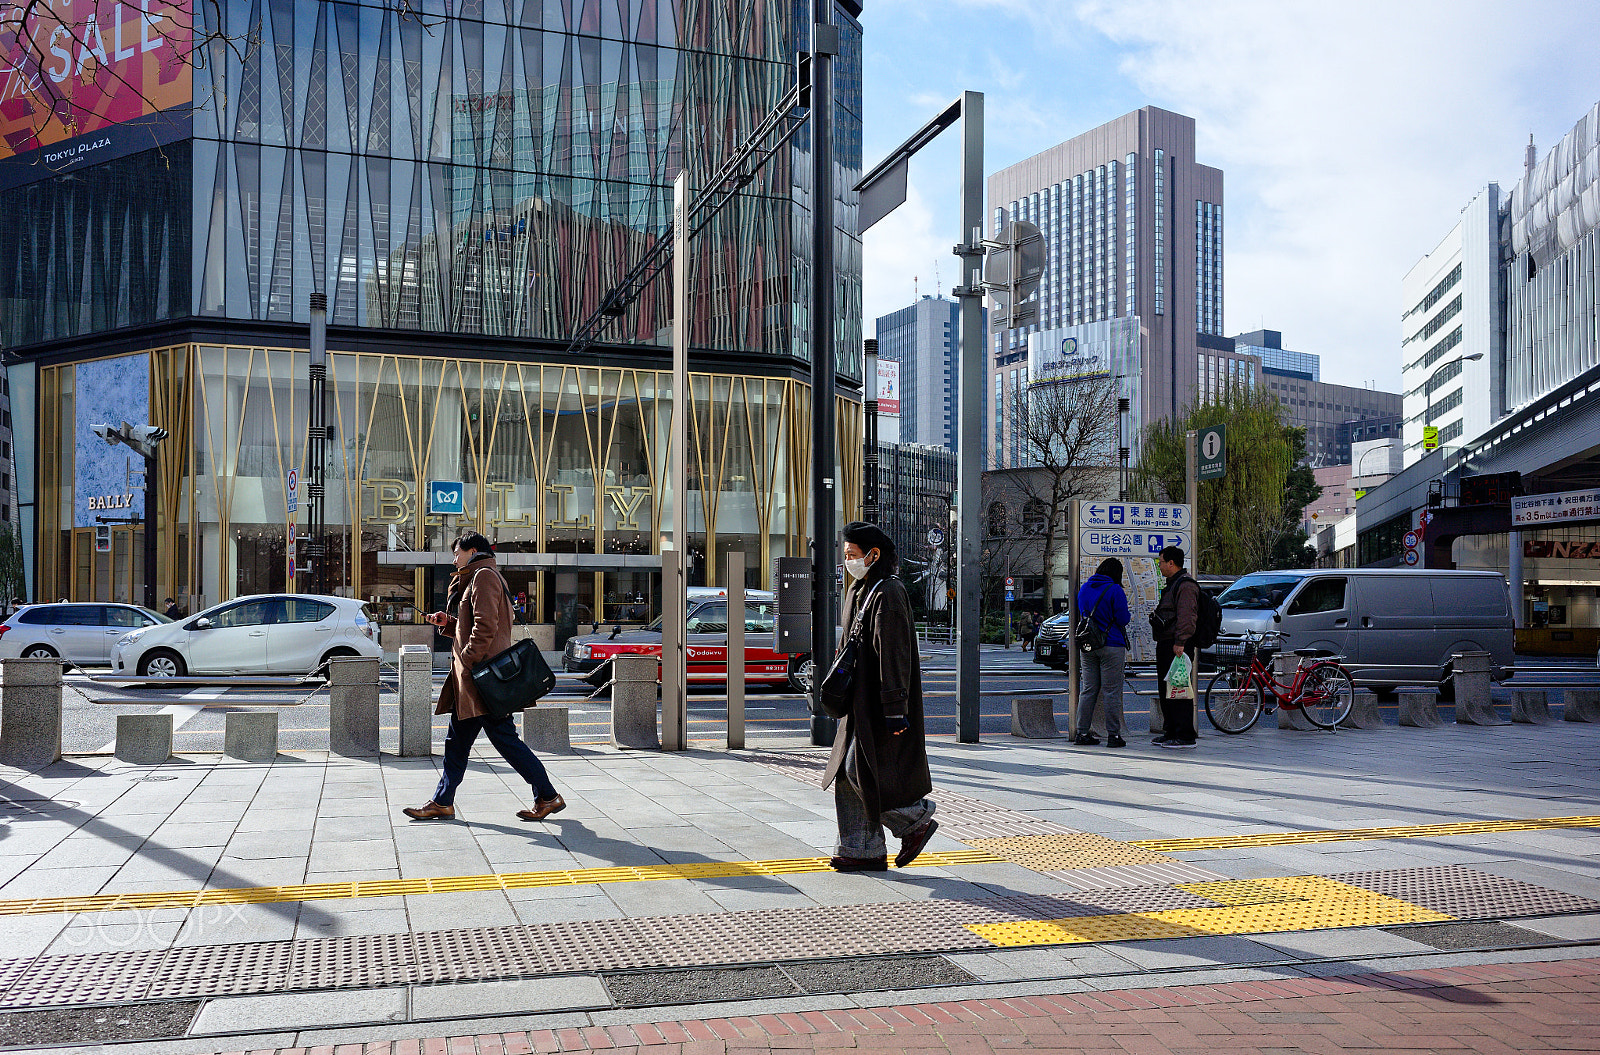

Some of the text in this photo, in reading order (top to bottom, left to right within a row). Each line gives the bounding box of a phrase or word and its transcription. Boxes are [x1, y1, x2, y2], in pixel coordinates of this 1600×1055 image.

[48, 0, 164, 83] SALE
[44, 137, 111, 164] TOKYU PLAZA
[88, 493, 133, 510] BALLY
[1130, 506, 1183, 519] 東銀座駅
[1088, 517, 1105, 525] 490m
[1090, 533, 1143, 545] 日比谷公園
[1100, 545, 1118, 553] Hibiya
